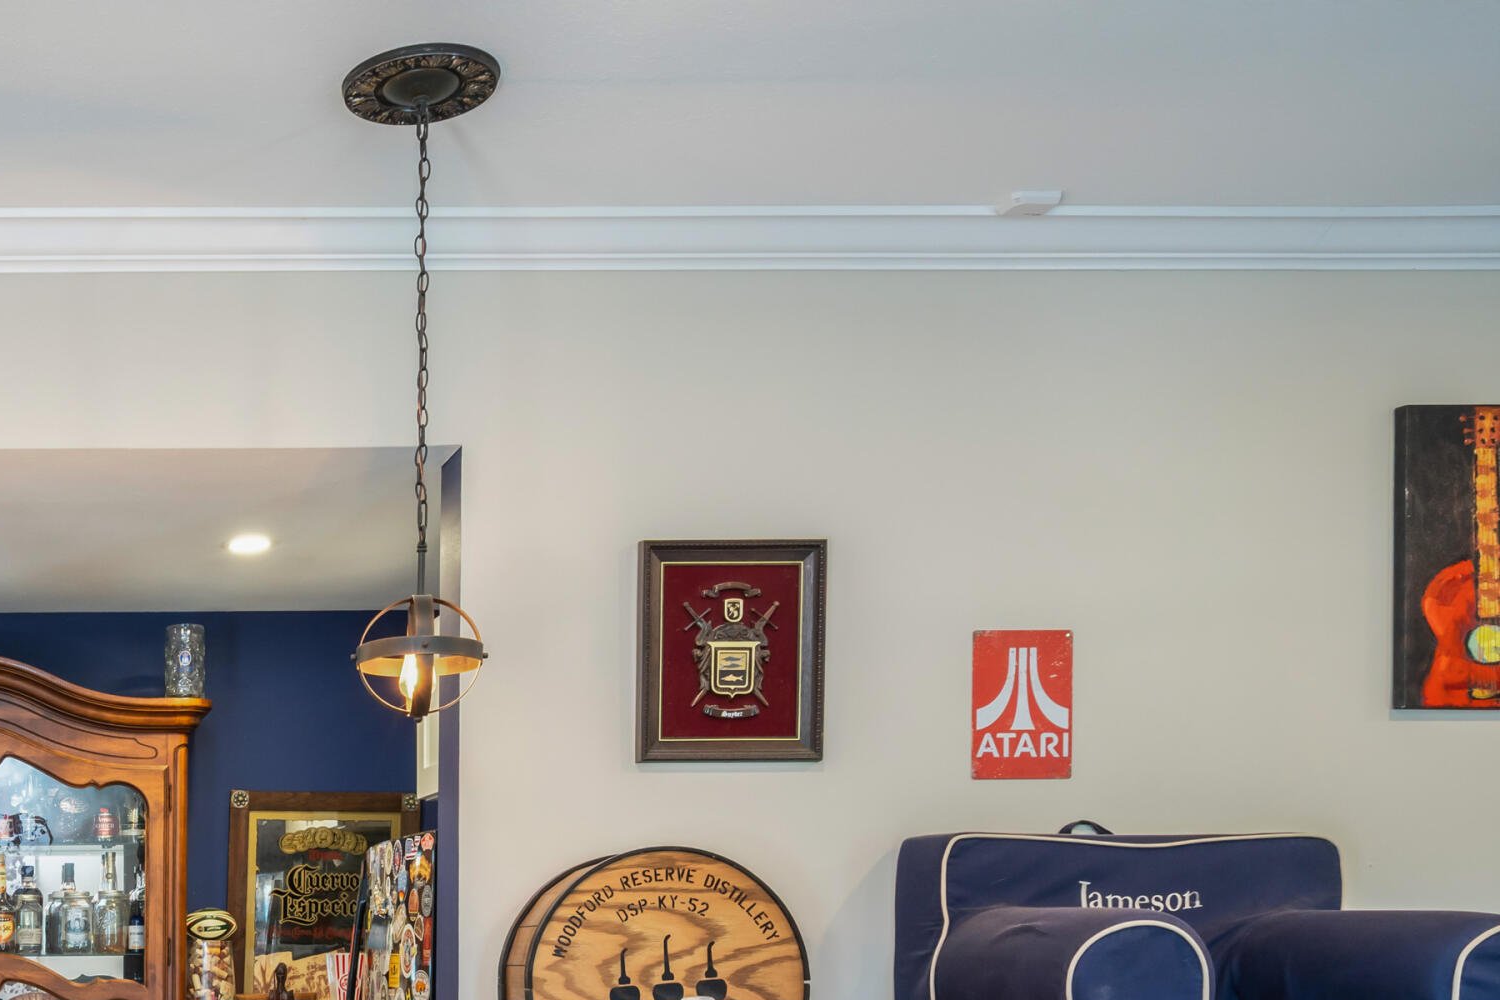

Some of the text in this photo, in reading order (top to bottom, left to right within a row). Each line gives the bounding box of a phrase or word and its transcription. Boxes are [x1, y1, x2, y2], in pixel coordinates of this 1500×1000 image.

[975, 732, 1069, 758] ATARI
[286, 863, 360, 897] Cuervo
[269, 891, 358, 926] Especi
[552, 866, 781, 959] WOODFORD RESERVE DISTILLERY
[616, 894, 710, 923] DSP-KY-52
